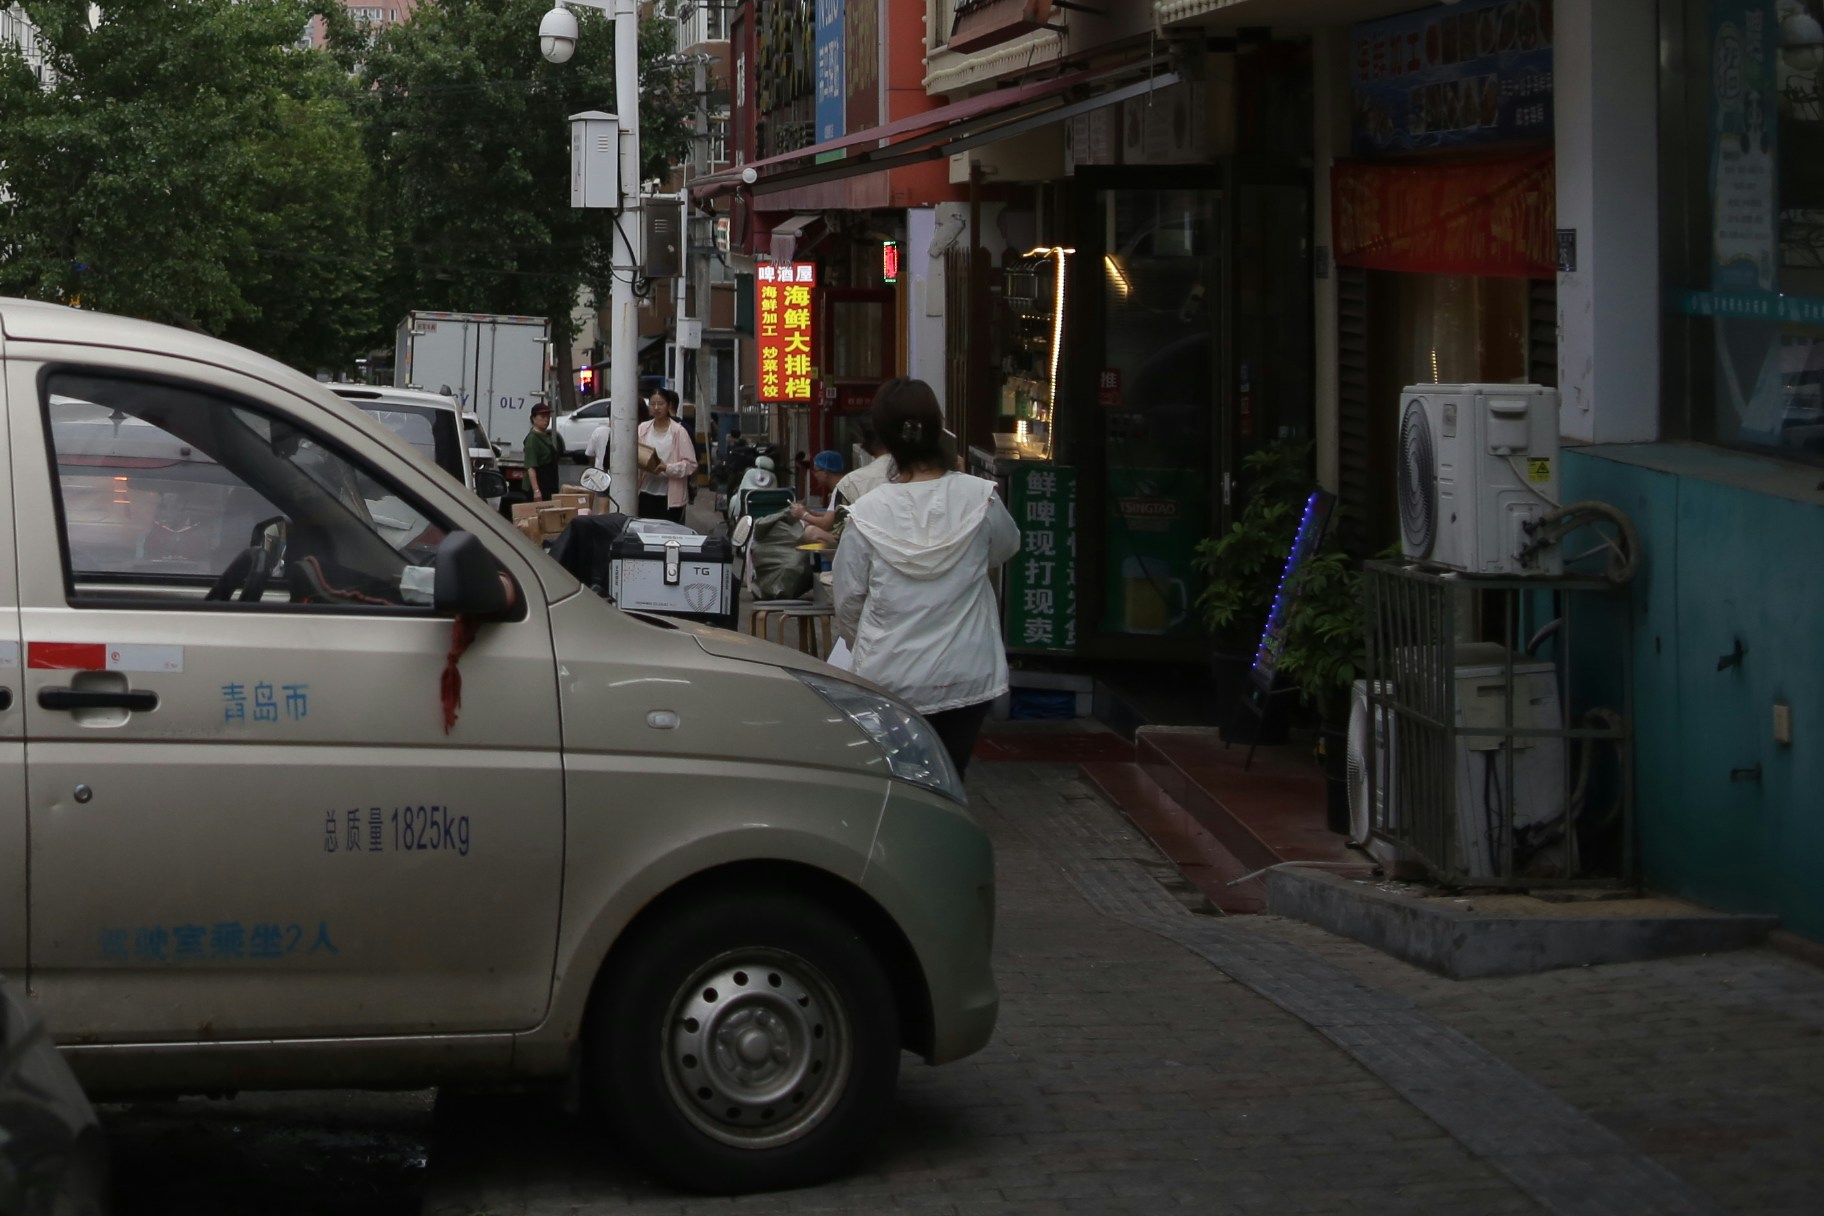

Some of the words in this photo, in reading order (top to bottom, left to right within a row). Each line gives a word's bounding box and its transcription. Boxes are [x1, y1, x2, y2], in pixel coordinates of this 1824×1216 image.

[758, 265, 813, 282] 啤酒屋
[761, 285, 778, 337] 海鲜加工
[783, 285, 811, 399] 海鲜大排档
[762, 346, 779, 398] 炒菜水饺
[1101, 371, 1118, 389] 推
[1118, 500, 1176, 515] TSINGTAO
[693, 567, 710, 576] TG
[1024, 469, 1057, 645] 鲜啤现打现卖
[222, 681, 310, 724] 青岛市
